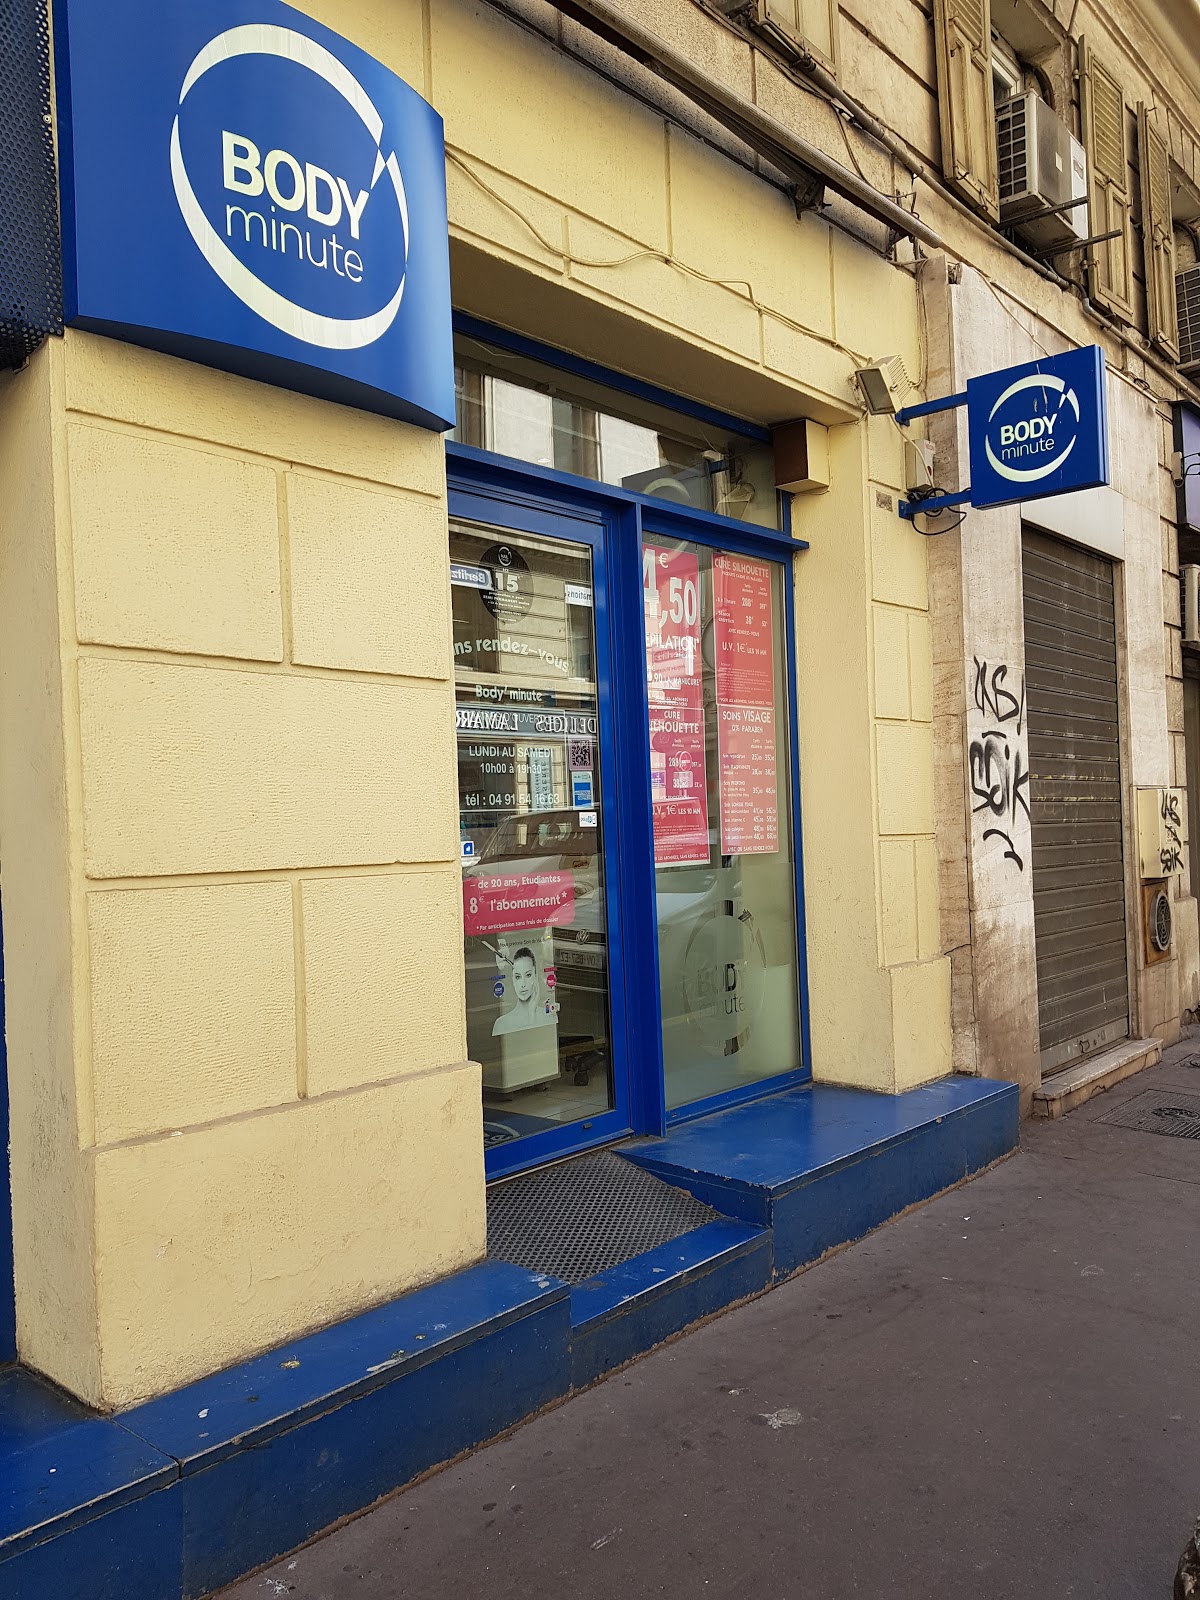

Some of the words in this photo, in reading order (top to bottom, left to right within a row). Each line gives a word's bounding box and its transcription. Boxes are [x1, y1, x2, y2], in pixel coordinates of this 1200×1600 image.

[222, 130, 369, 240] BODY
[226, 203, 364, 283] minute
[1000, 413, 1057, 446] BODY
[1001, 437, 1055, 461] minute
[714, 558, 730, 570] CURE
[732, 562, 769, 578] SILHOUETTE
[722, 642, 735, 652] U.V.
[476, 637, 570, 673] rendez-vous
[510, 689, 542, 702] minute
[664, 710, 680, 720] CURE
[722, 711, 740, 721] SOINS
[743, 710, 771, 723] VISAGE
[468, 746, 500, 757] LUNDI
[502, 746, 515, 758] AU
[518, 747, 553, 758] SAMEDI
[480, 762, 506, 774] 10h00
[509, 764, 514, 774] à
[516, 764, 542, 774] 19h30
[465, 794, 480, 806] tél
[488, 794, 502, 806] 04
[504, 794, 516, 805] 91
[518, 794, 532, 804] 54
[535, 794, 546, 804] 16
[548, 794, 560, 804] 63
[478, 880, 489, 889] de
[490, 879, 502, 888] 20
[504, 878, 520, 888] ans,
[522, 874, 560, 885] Etudiantes
